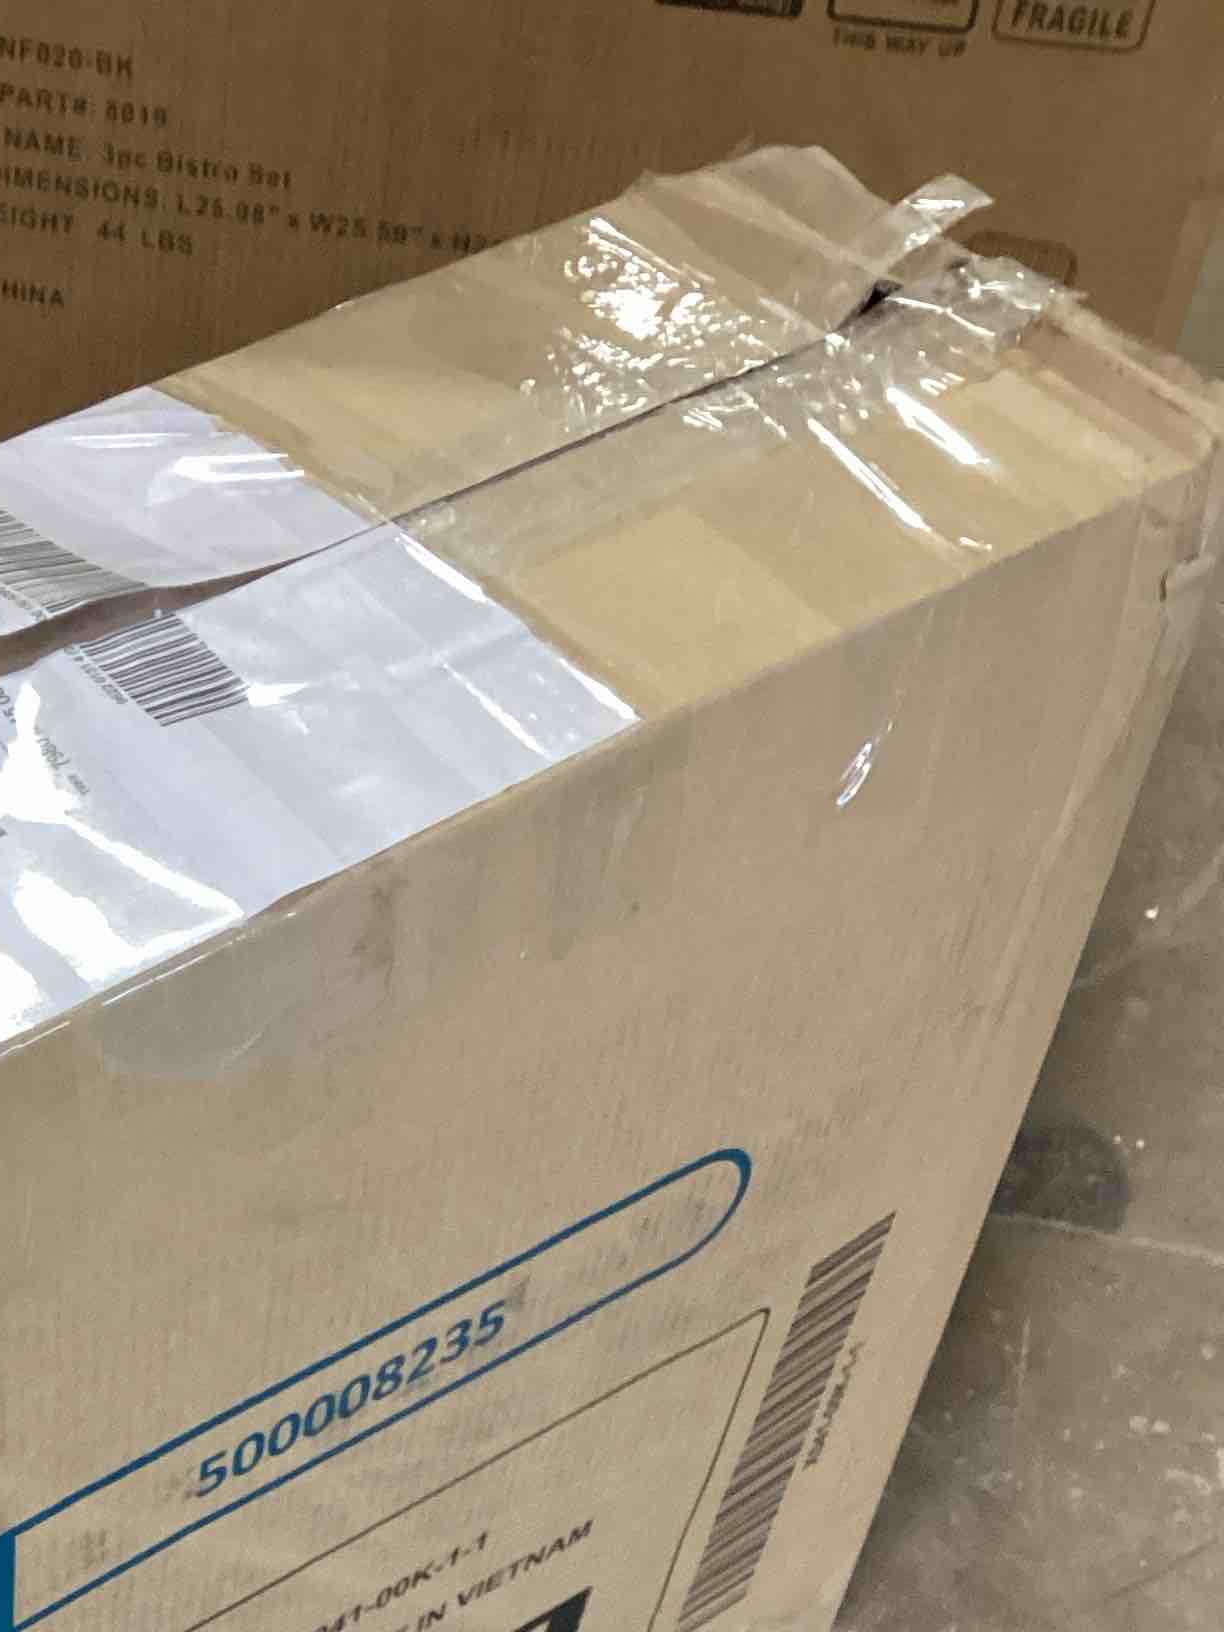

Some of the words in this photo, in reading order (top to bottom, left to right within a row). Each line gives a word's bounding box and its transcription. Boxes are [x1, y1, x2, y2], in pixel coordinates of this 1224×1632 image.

[1010, 0, 1131, 41] FRAGILE
[887, 36, 927, 57] WAY
[938, 40, 966, 58] UP
[156, 149, 238, 184] Bistro
[96, 219, 126, 245] 44
[140, 226, 194, 255] LBS
[194, 1297, 509, 1500] 500008235
[457, 1519, 596, 1612] VIETNAM
